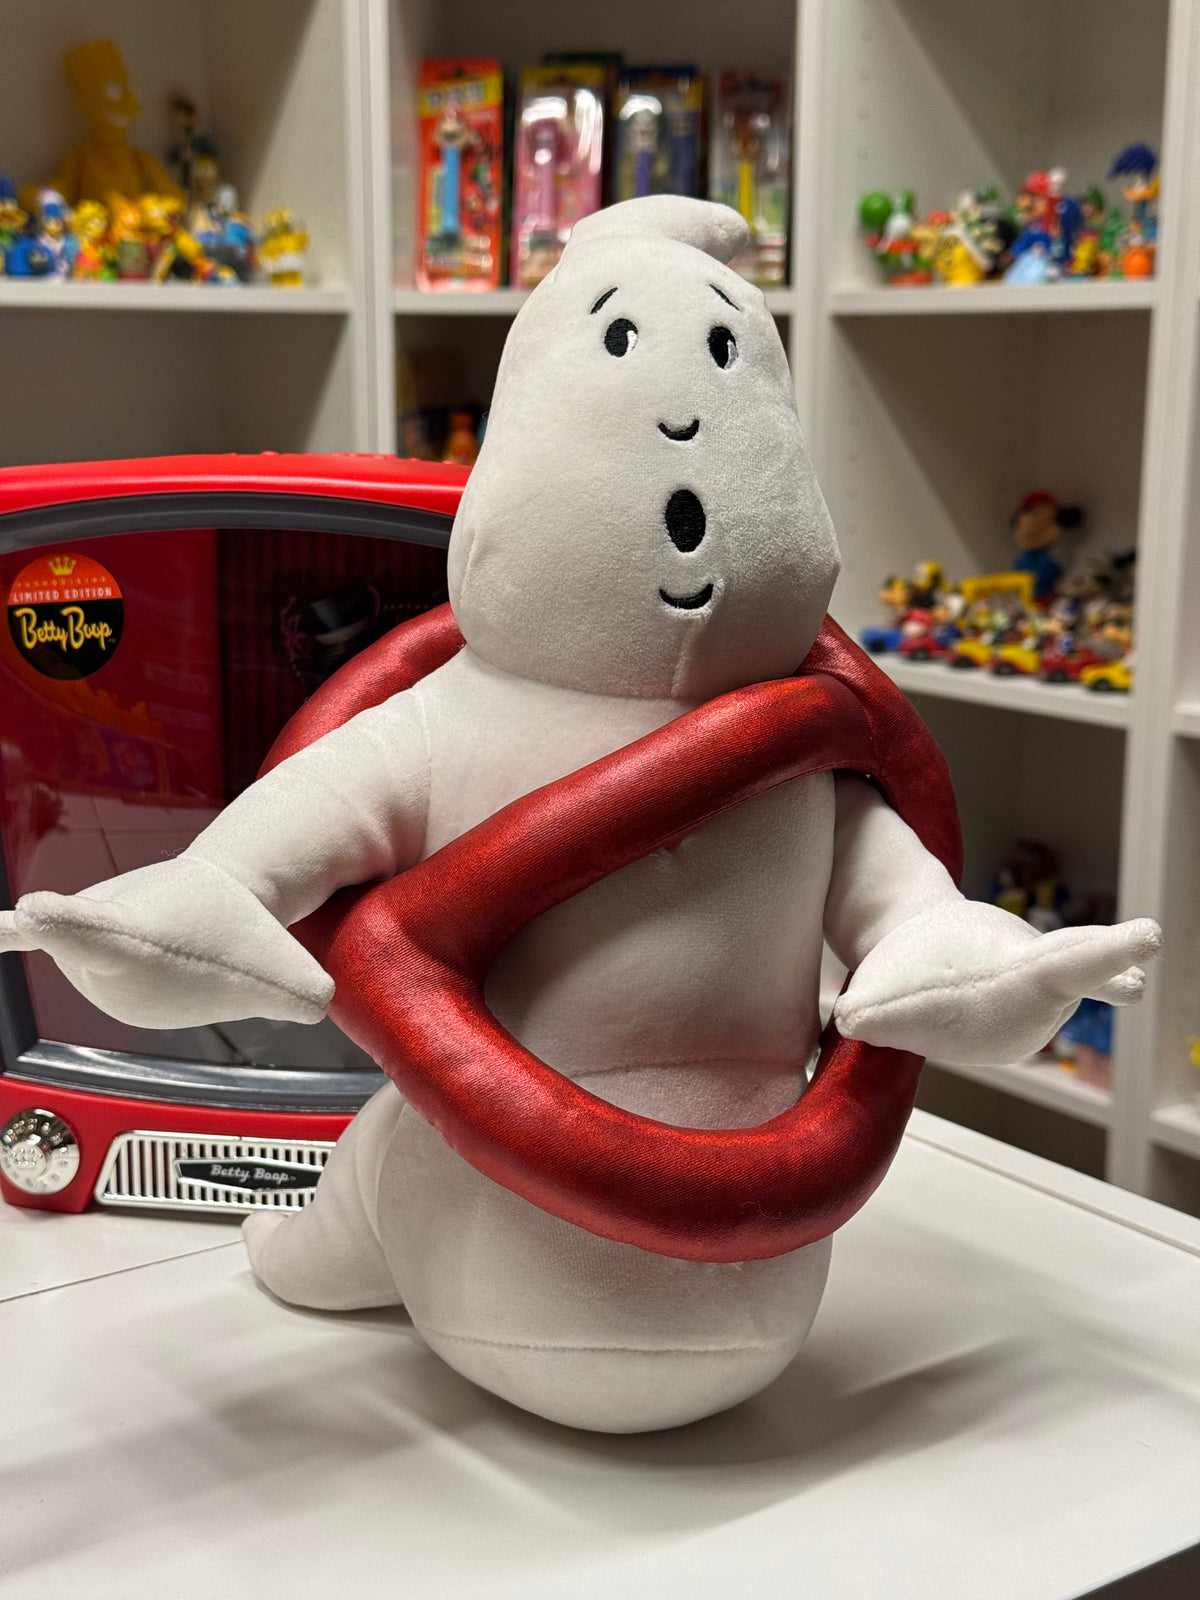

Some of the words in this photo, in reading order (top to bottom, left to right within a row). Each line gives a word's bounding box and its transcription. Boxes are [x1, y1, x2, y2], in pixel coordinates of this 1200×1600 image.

[13, 590, 60, 603] LIMITED
[64, 587, 112, 600] EDITION
[14, 607, 69, 652] Betty
[61, 606, 113, 650] Boop
[210, 1164, 251, 1183] Betty
[254, 1167, 290, 1185] Boop
